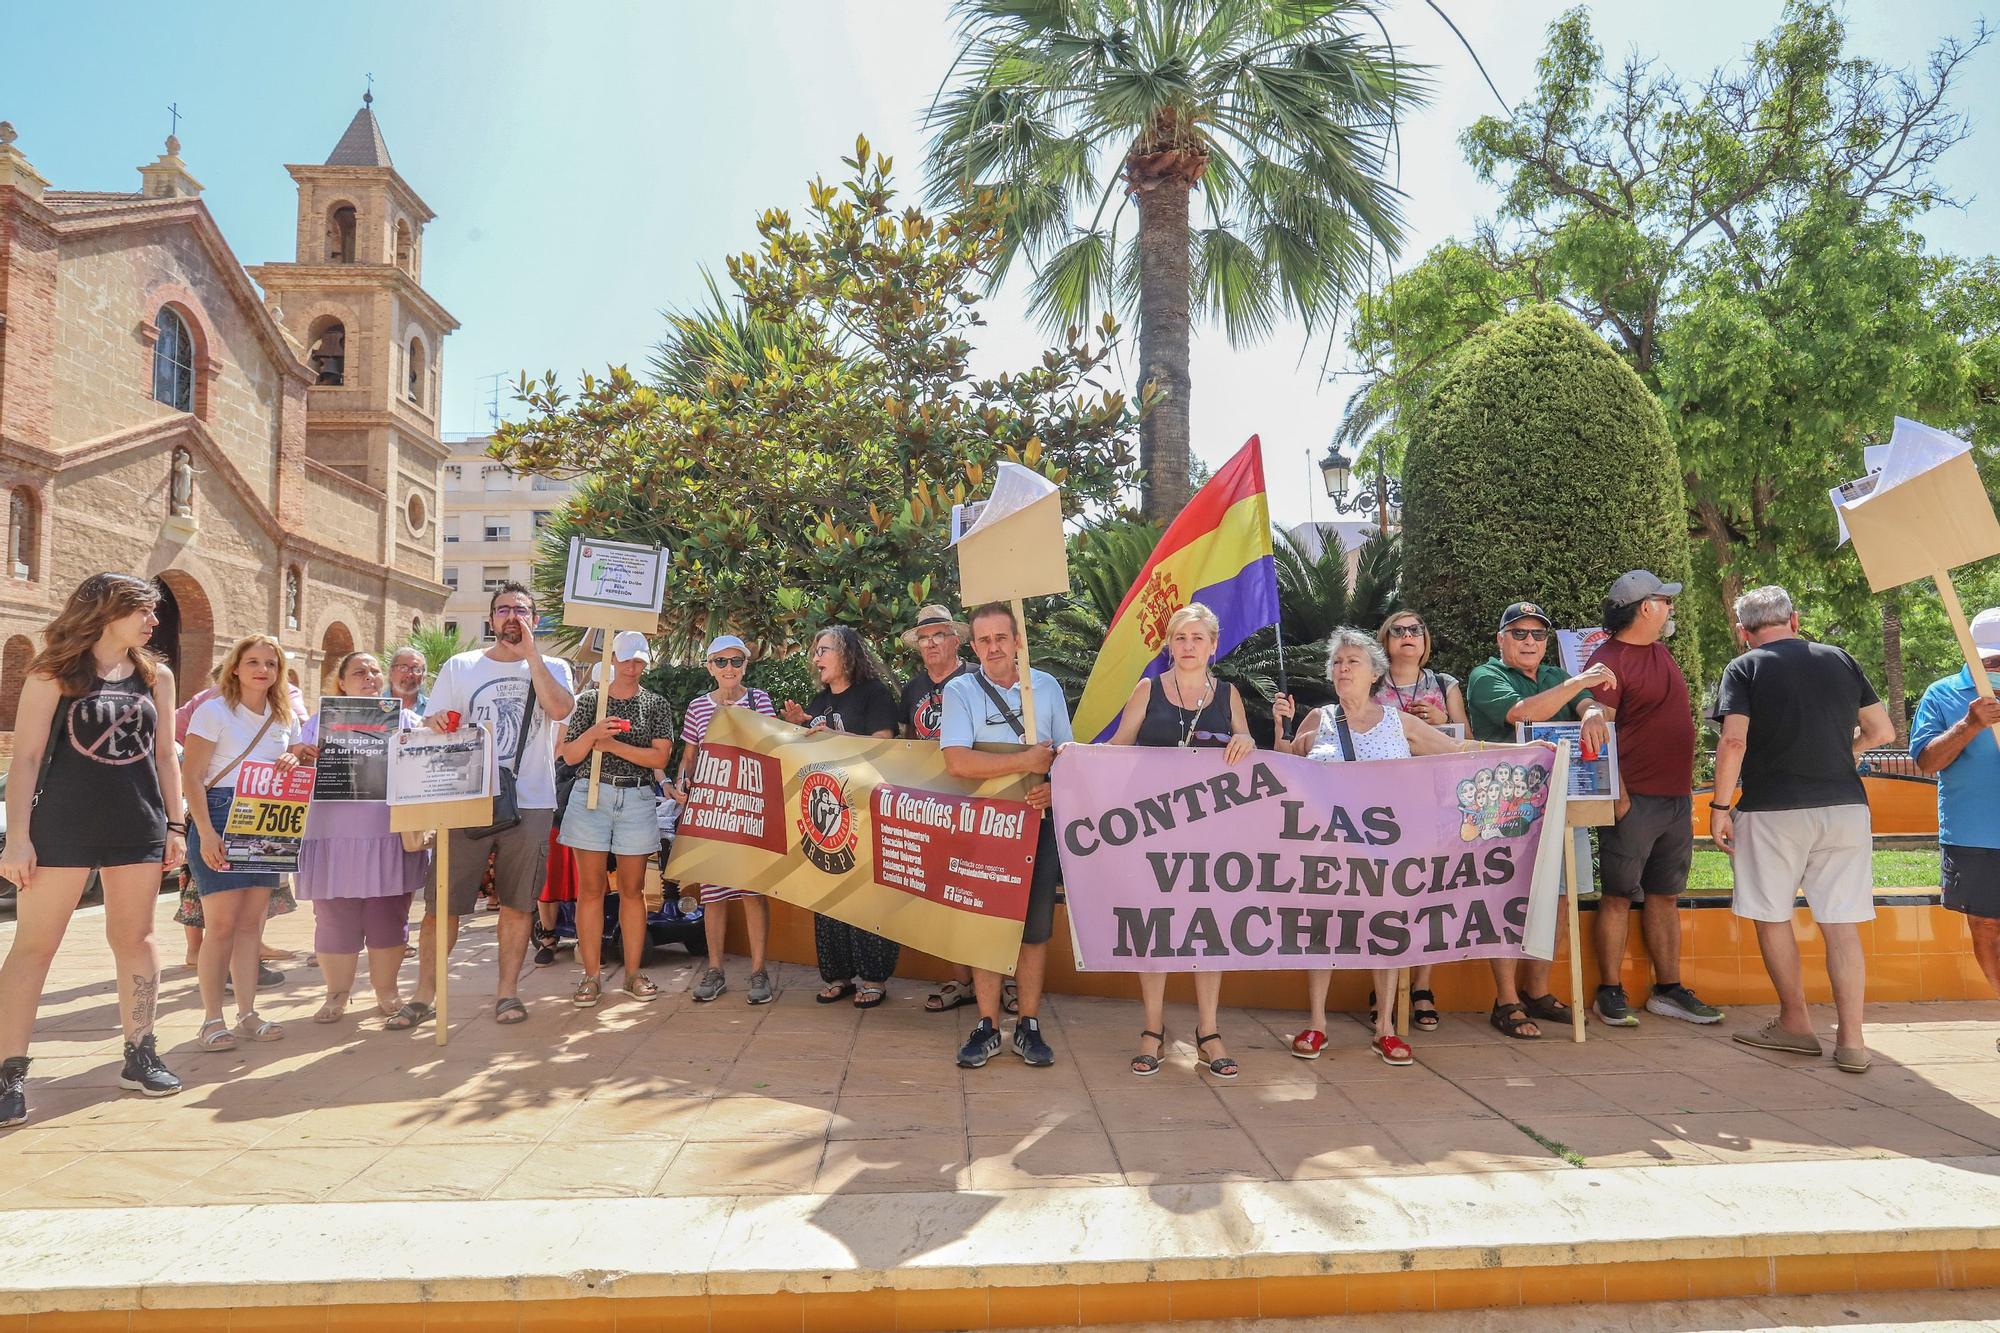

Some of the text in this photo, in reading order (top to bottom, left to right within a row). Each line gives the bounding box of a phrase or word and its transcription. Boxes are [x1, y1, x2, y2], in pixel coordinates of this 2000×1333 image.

[477, 706, 491, 720] 71
[326, 736, 346, 745] Una
[348, 737, 368, 746] caja
[354, 747, 384, 756] hogar
[242, 766, 288, 796] 118€
[694, 750, 732, 787] Una
[737, 755, 763, 794] RED
[688, 787, 764, 814] para organizar
[880, 789, 894, 817] Tu
[959, 802, 976, 832] Tu
[980, 806, 1025, 840] Das!
[1064, 762, 1287, 857] CONTRA
[682, 803, 764, 838] la solidaridad
[1279, 800, 1401, 845] LAS
[1146, 846, 1514, 897] VIOLENCIAS
[1112, 897, 1529, 957] MACHISTAS
